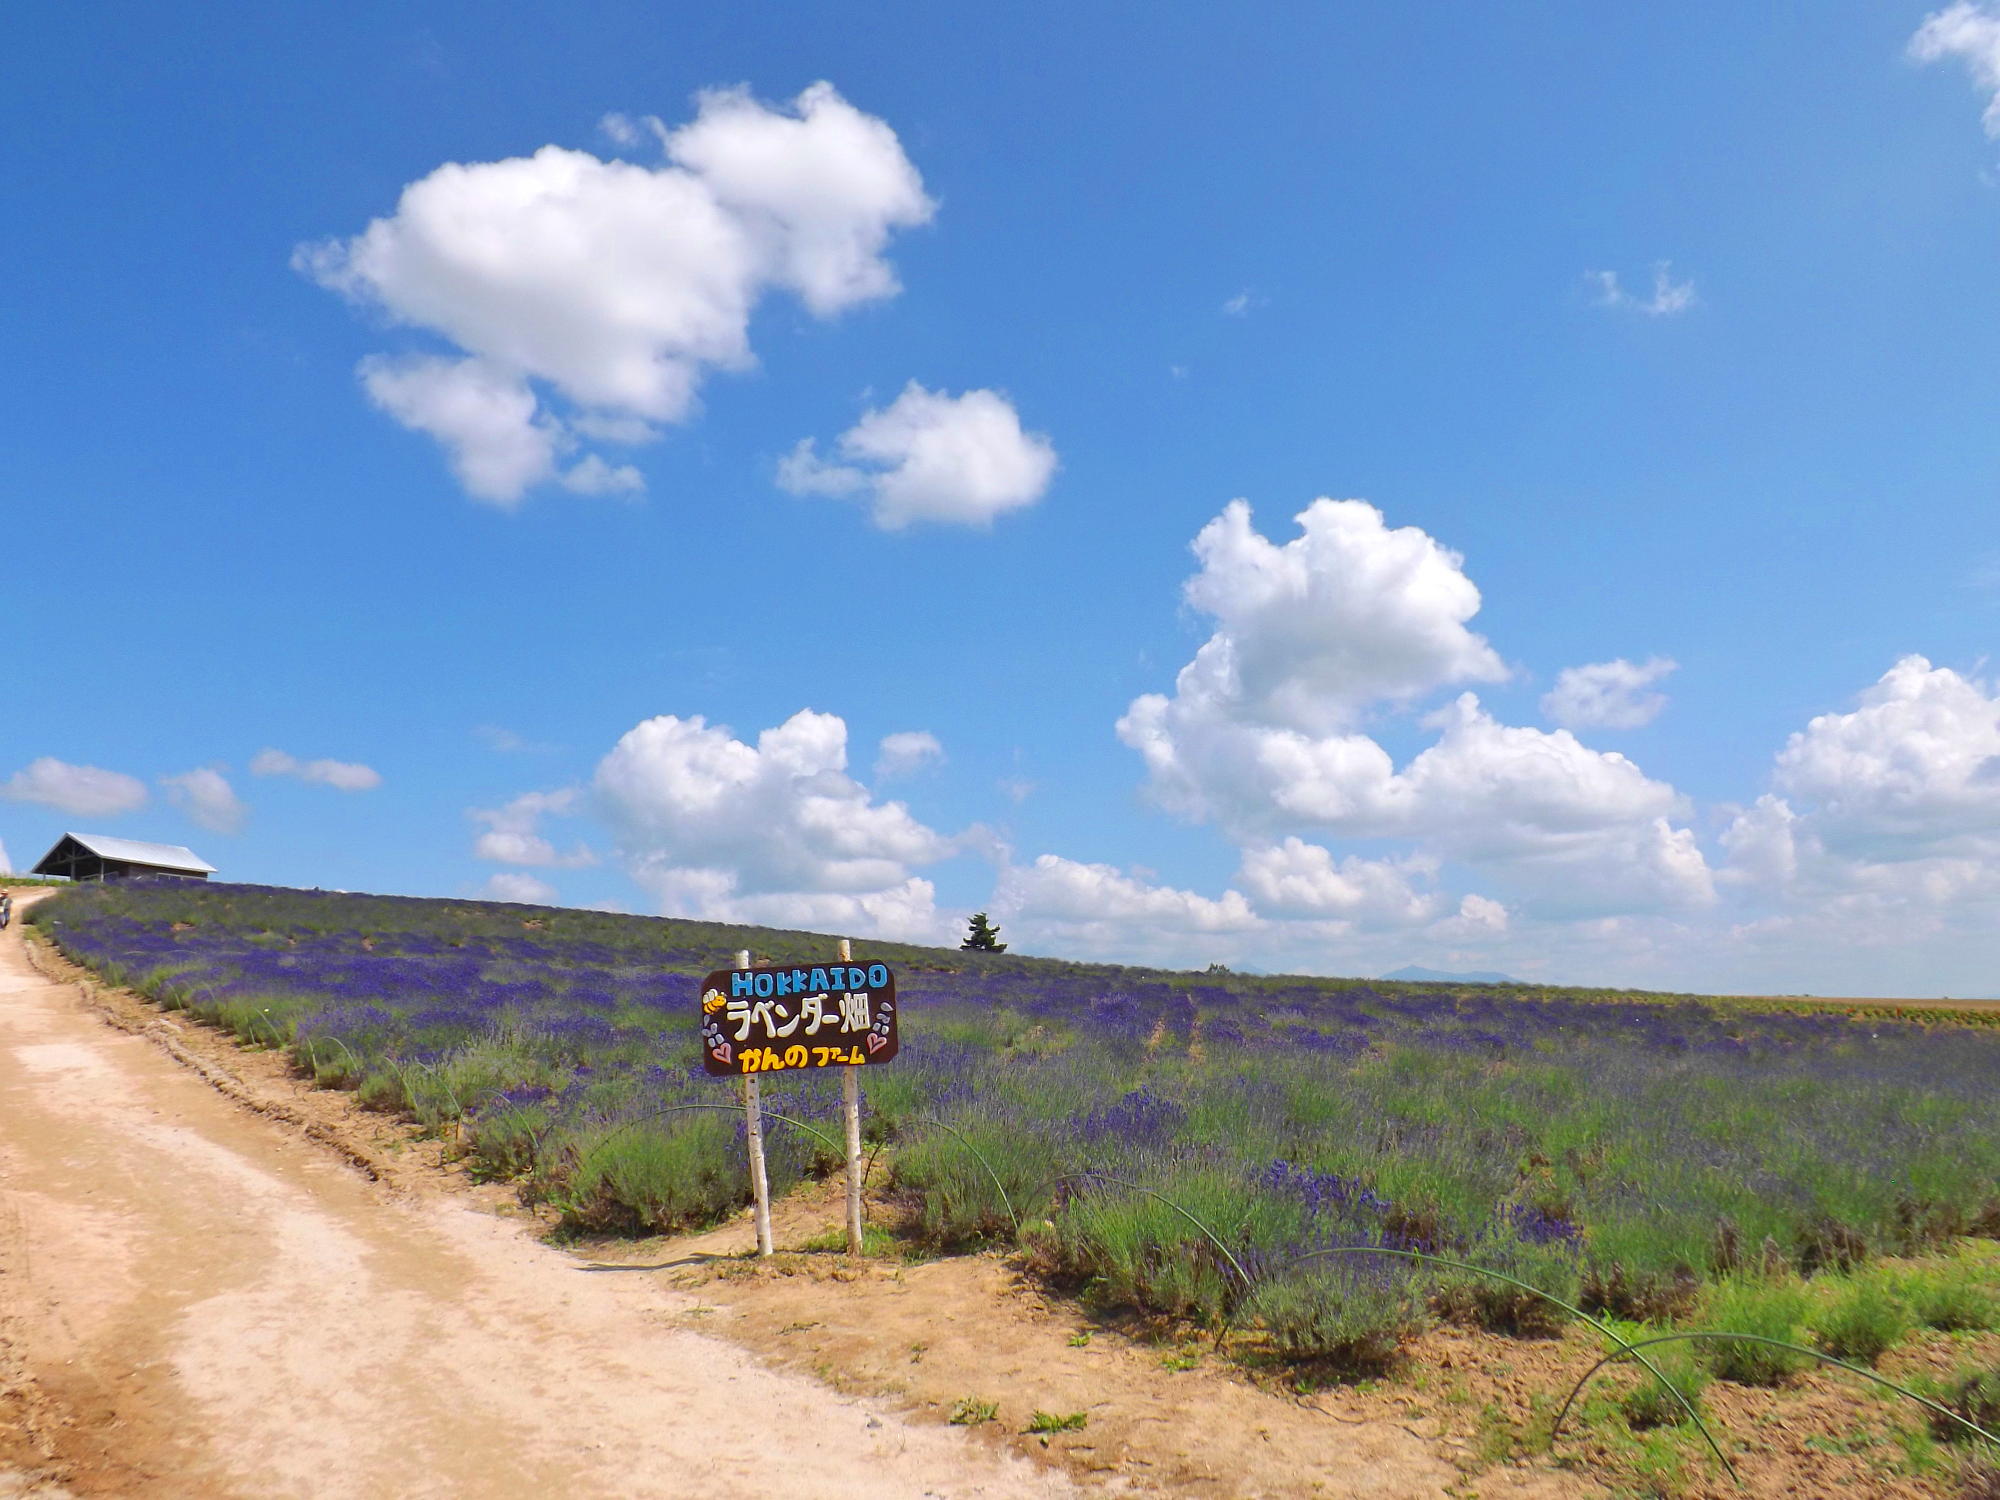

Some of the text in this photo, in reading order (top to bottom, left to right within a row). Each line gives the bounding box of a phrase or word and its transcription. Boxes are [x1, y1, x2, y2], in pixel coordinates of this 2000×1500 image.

[731, 964, 888, 997] HOKKAIDO
[726, 992, 871, 1042] ラベンダー畑
